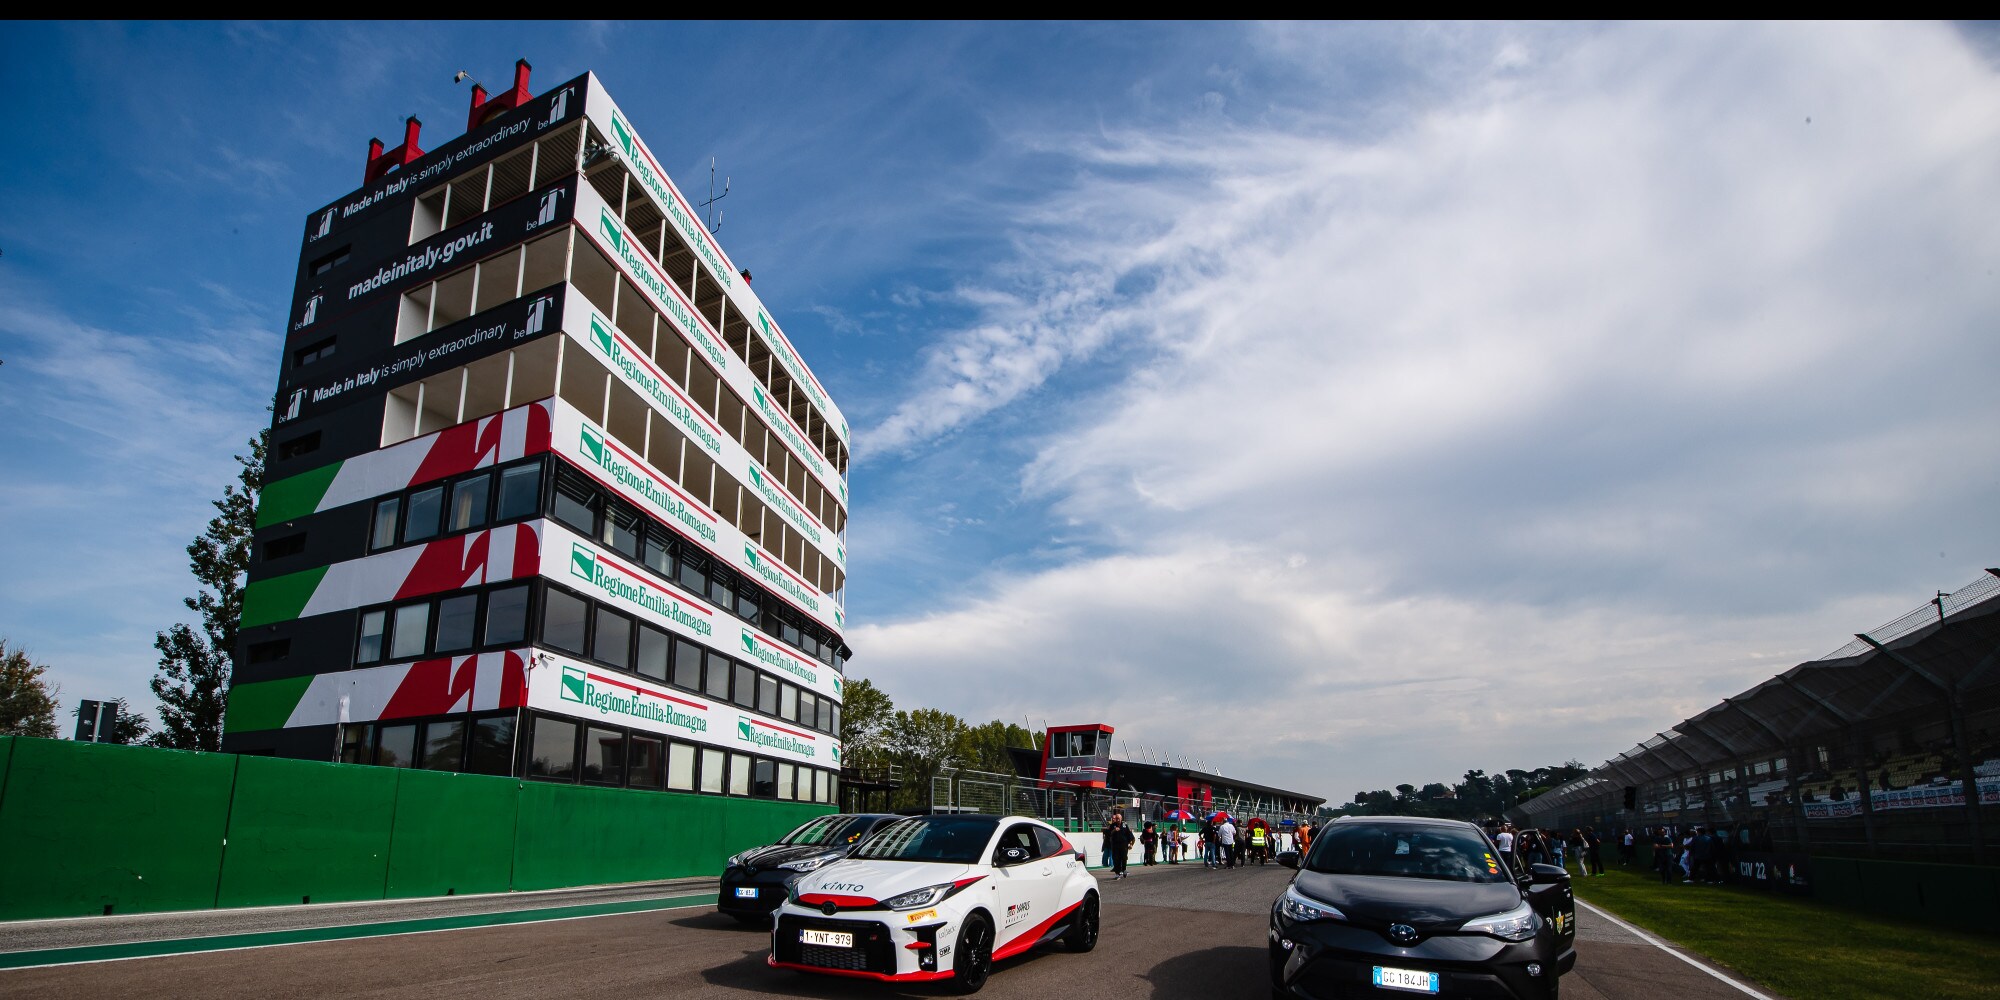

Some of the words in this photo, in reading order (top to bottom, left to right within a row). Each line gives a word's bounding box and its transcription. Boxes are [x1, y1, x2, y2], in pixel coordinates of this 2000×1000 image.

[343, 196, 372, 218] Made
[373, 190, 384, 203] in
[385, 177, 409, 197] Italy
[410, 173, 418, 185] is
[419, 154, 454, 180] simply
[456, 117, 531, 162] extraordinary
[348, 221, 494, 299] madeinitaly.gov.it
[312, 382, 342, 403] Made
[344, 378, 354, 392] in
[356, 368, 379, 385] Italy
[381, 364, 389, 378] is
[391, 350, 426, 374] simply
[428, 323, 507, 360] extraordinary
[1740, 862, 1753, 877] CIV
[1755, 862, 1767, 879] 22
